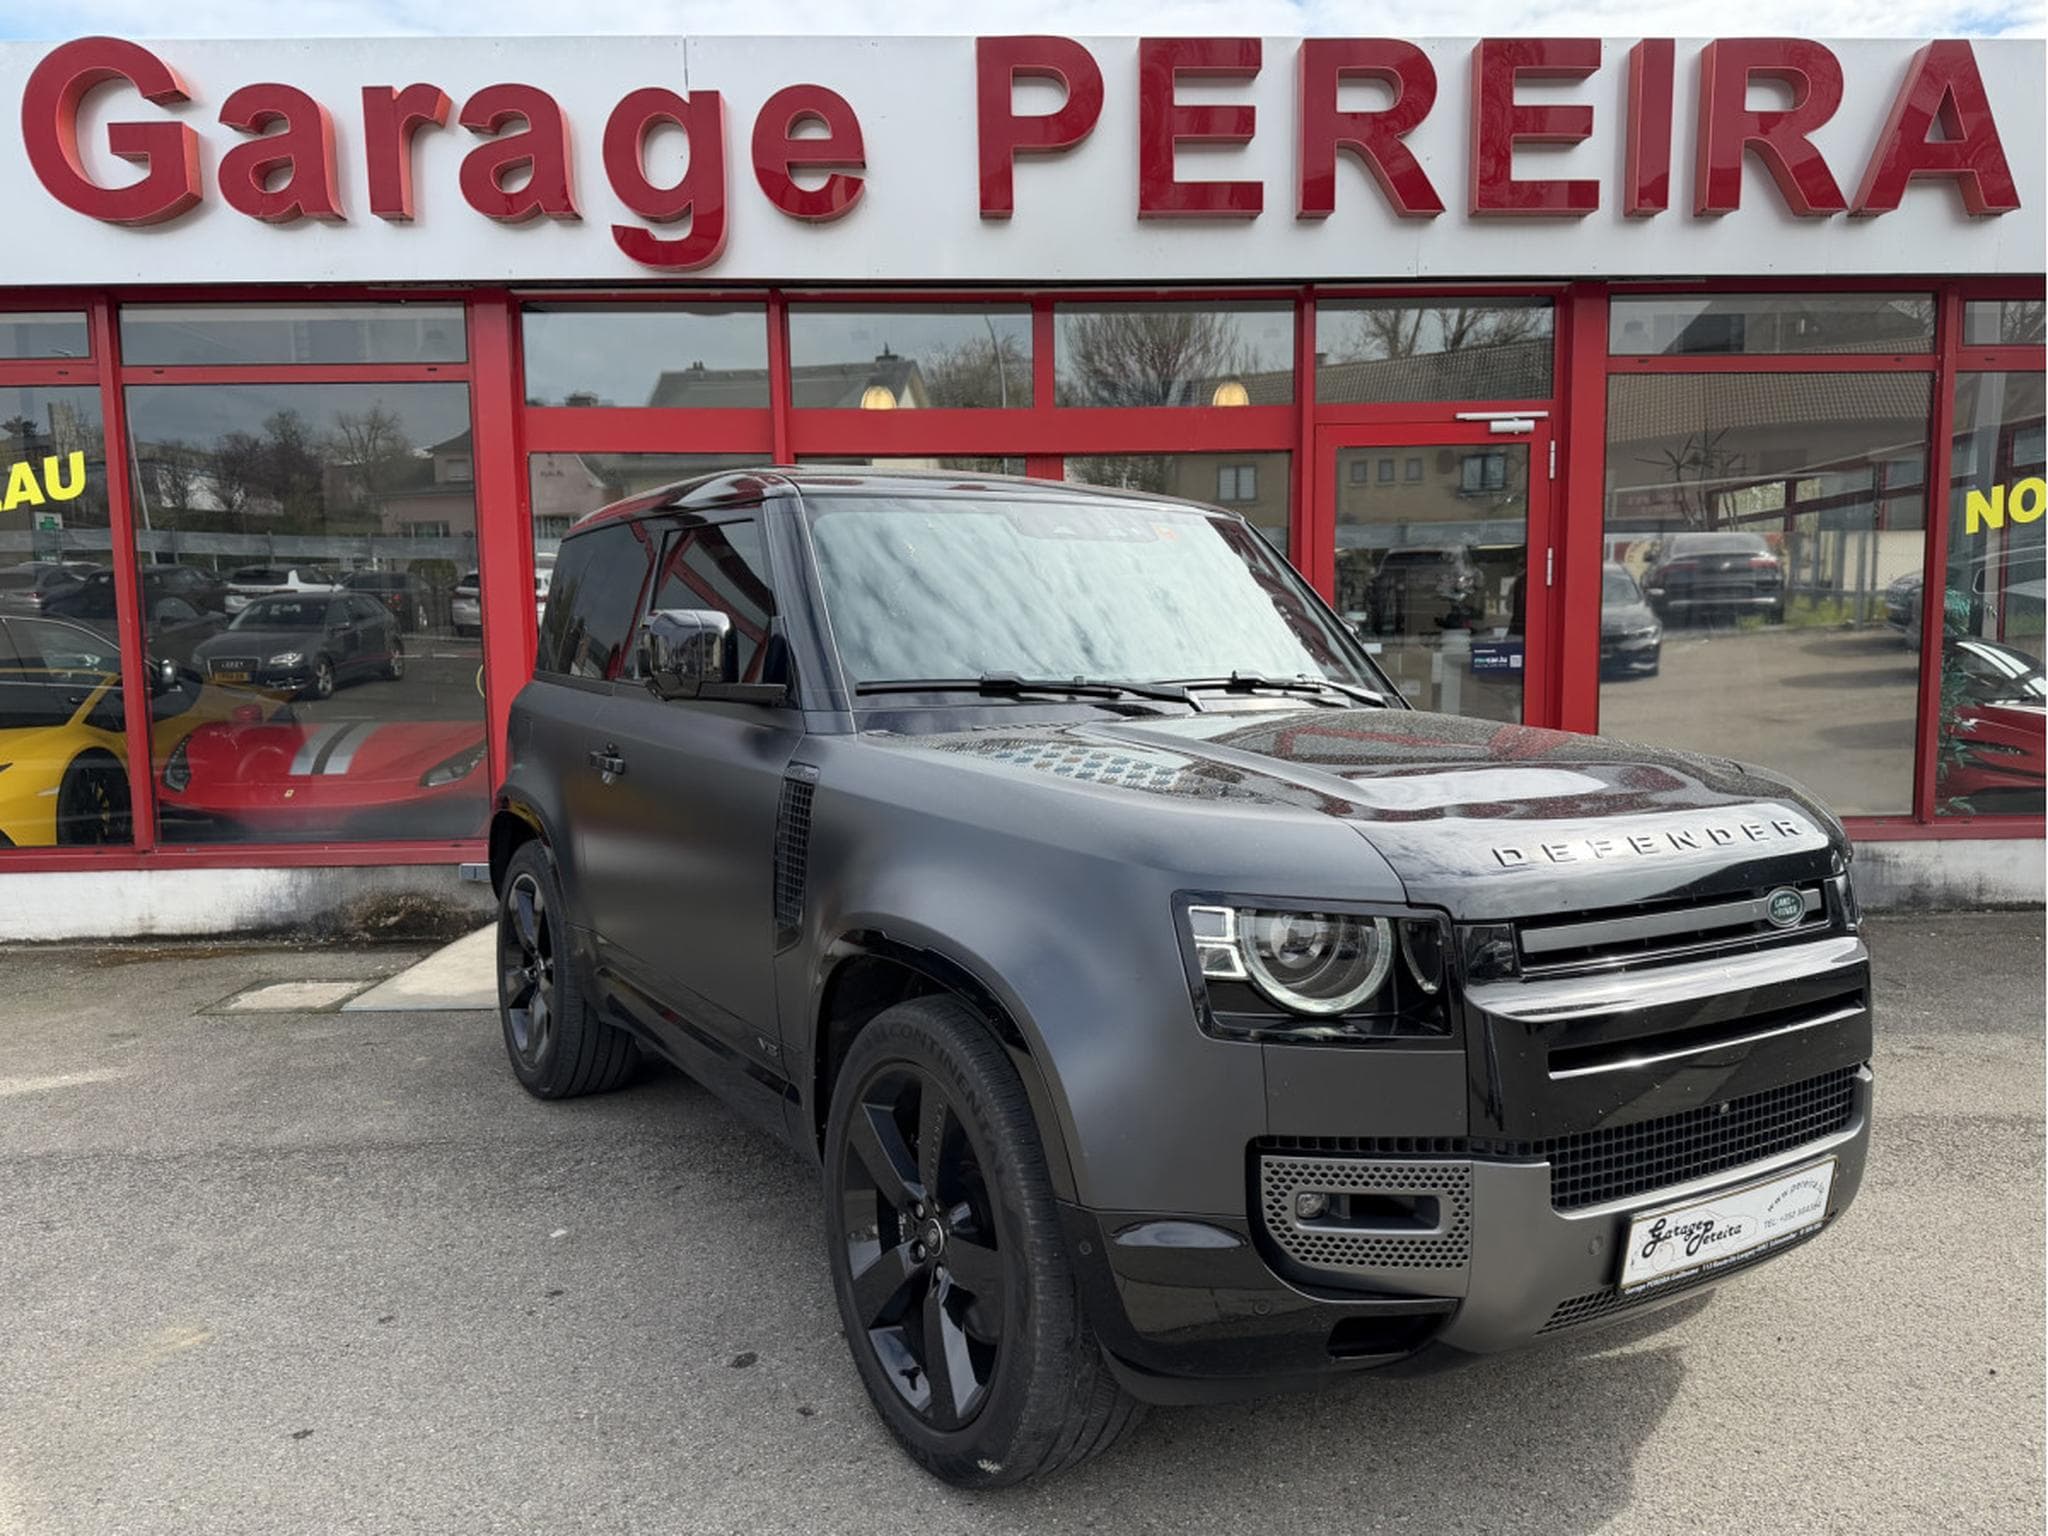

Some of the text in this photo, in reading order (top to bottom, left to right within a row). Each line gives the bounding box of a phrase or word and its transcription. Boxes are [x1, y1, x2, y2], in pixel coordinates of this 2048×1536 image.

[22, 36, 2022, 272] Garage PEREIRA
[0, 451, 86, 511] AU
[1965, 477, 2047, 535] NO
[1491, 820, 1802, 868] DEFENDER
[1641, 1218, 1703, 1259] Garage
[1686, 1220, 1742, 1256] Pereira
